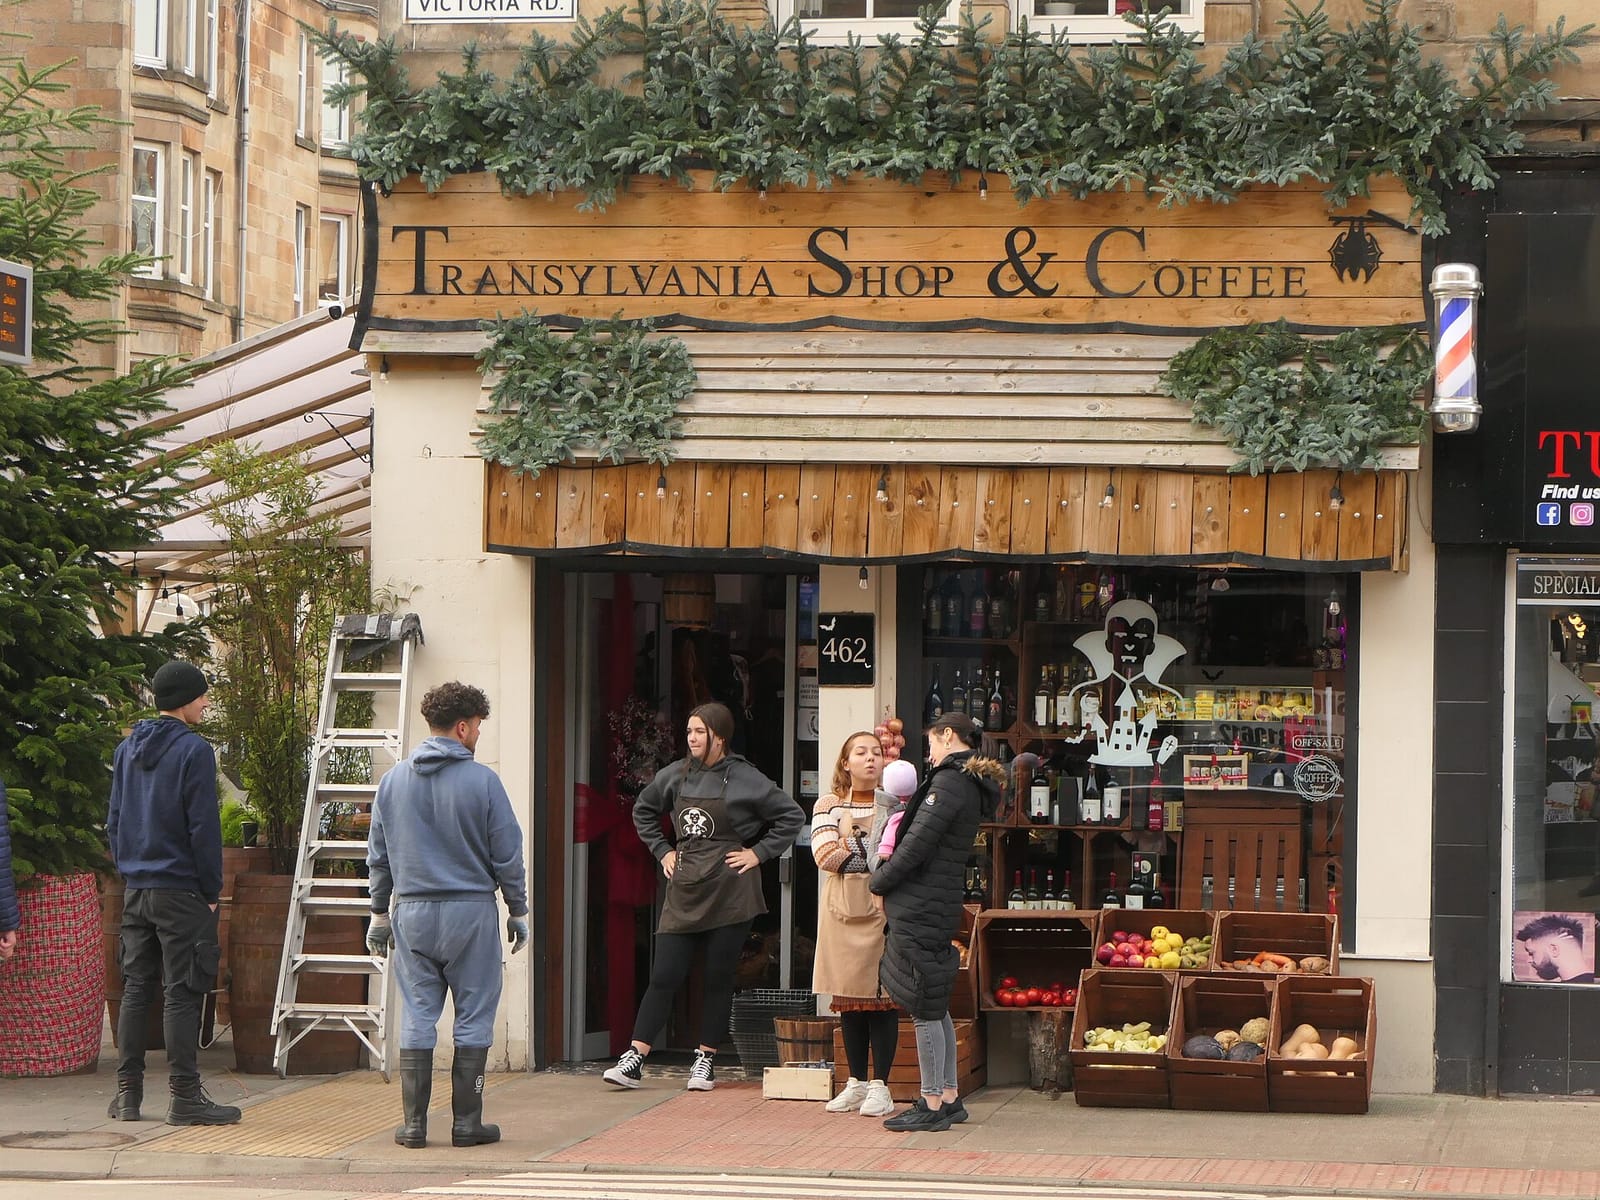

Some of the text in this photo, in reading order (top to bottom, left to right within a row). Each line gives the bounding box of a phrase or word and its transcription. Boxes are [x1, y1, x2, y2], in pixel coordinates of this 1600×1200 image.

[420, 0, 565, 11] VICTORIA RD.
[391, 225, 1309, 298] TRANSYLVANIA SHOP & COFFEE
[1541, 484, 1579, 500] Find
[821, 637, 867, 663] 462
[1294, 738, 1341, 748] OFF-SALE
[1304, 773, 1330, 783] COFFEE
